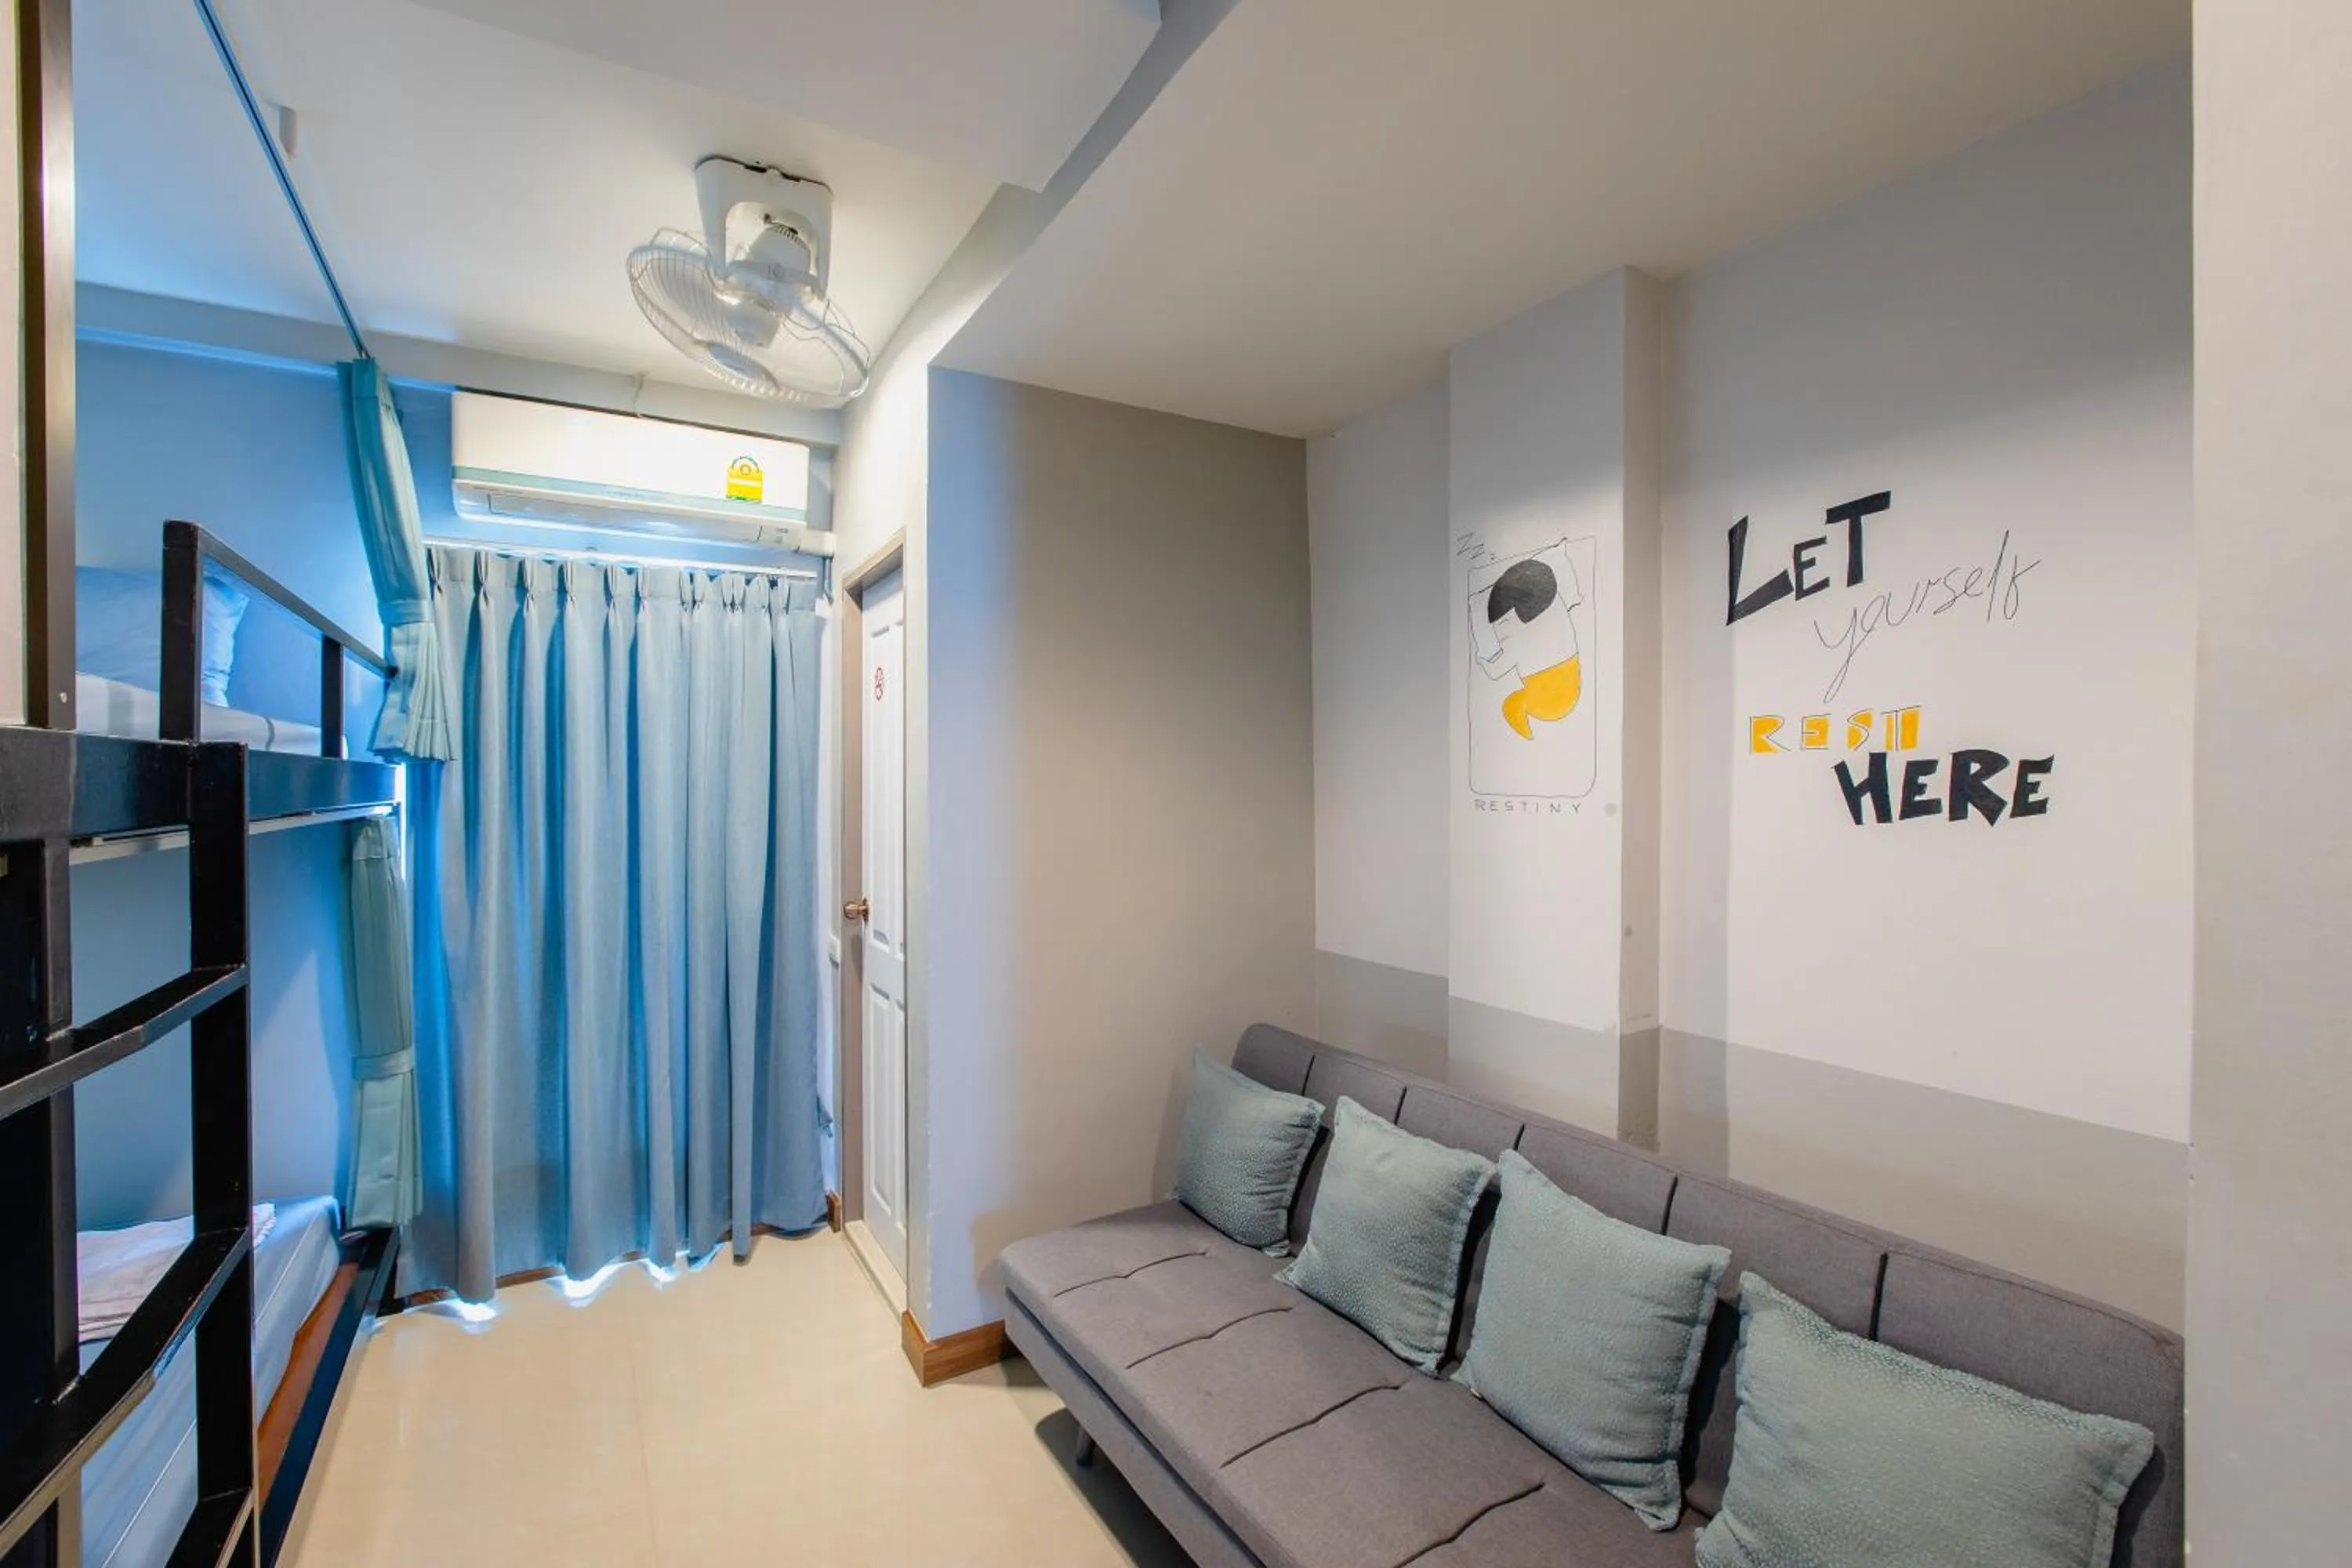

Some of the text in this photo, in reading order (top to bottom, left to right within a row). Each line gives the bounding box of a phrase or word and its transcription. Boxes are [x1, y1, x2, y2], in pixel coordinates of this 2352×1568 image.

[1726, 490, 1891, 626] LET
[1813, 529, 2042, 703] yourself
[1749, 706, 1922, 753] REST
[1474, 799, 1581, 814] RESTINY
[1831, 749, 2055, 826] HERE
